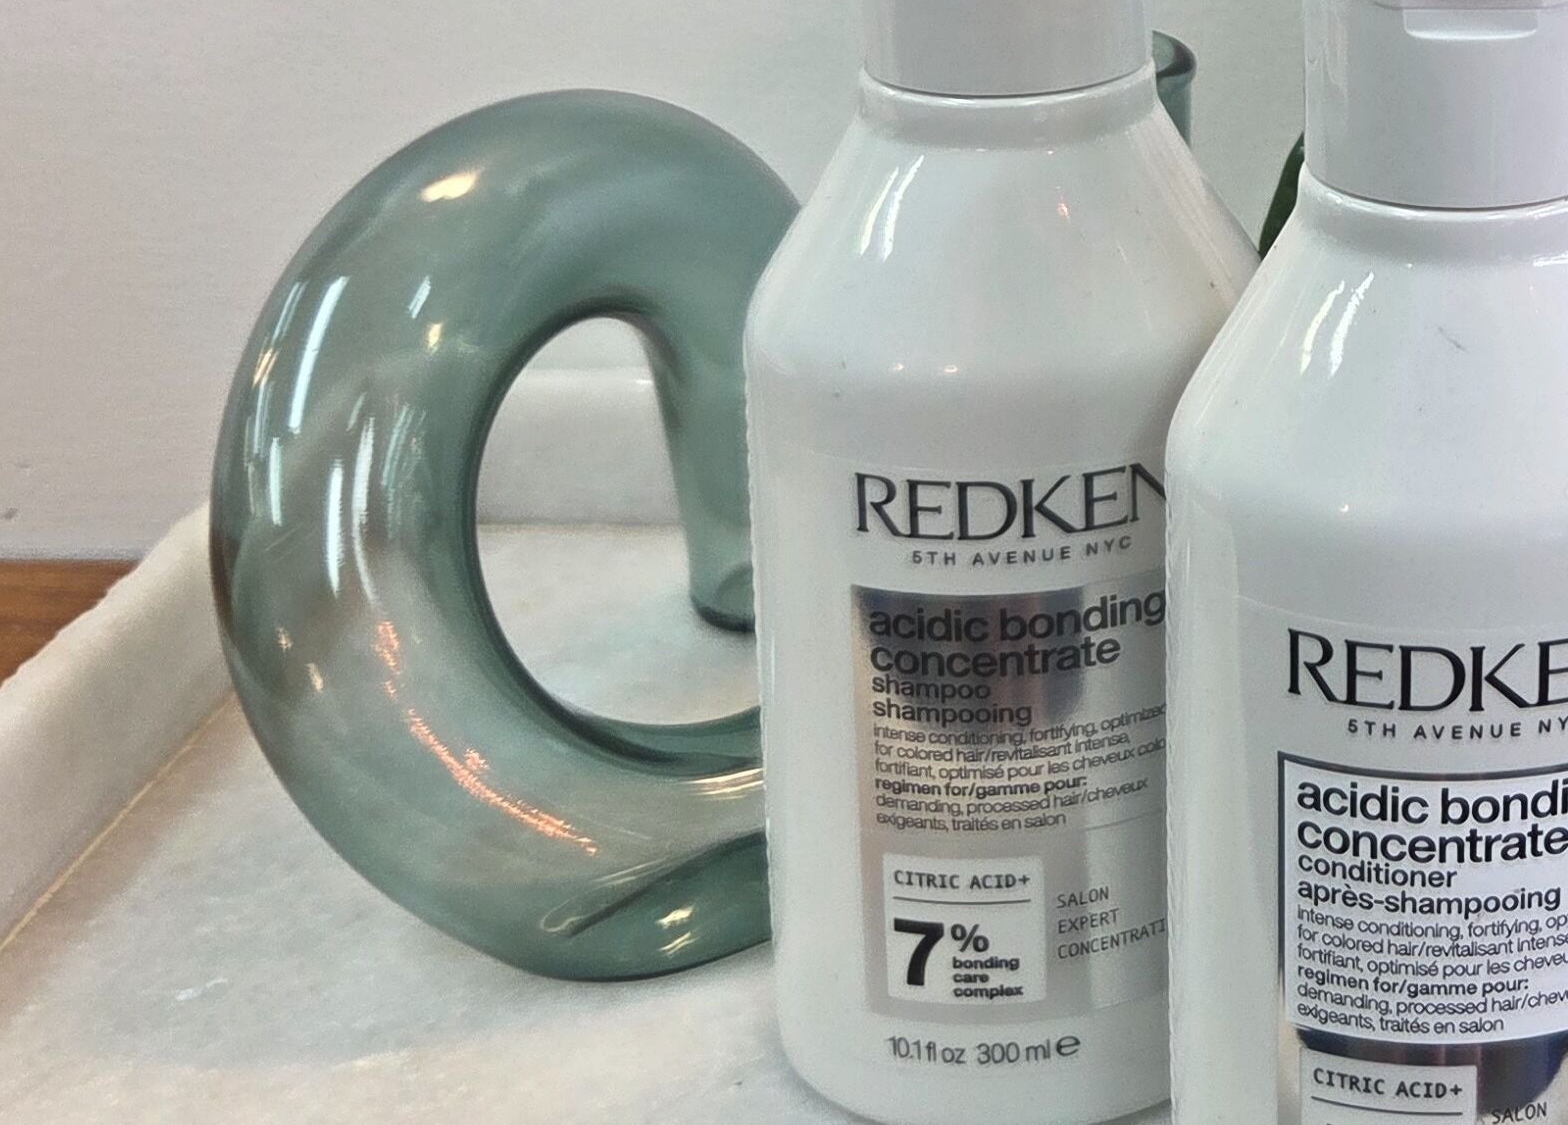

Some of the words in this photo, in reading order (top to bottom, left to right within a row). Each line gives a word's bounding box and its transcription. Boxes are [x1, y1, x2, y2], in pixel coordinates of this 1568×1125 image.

[912, 551, 955, 565] 5TH
[972, 546, 1071, 565] AVENUE
[1085, 536, 1132, 556] NYC
[869, 608, 989, 642] acidic
[1000, 590, 1166, 642] bonding
[870, 637, 1121, 677] concentrate
[872, 673, 991, 703] shampoo
[872, 699, 1032, 726] shampooing
[873, 725, 925, 743] intense
[1348, 719, 1396, 738] 5TH
[1414, 722, 1521, 740] AVENUE
[875, 742, 893, 756] for
[897, 746, 953, 762] colored
[939, 765, 1004, 781] optimisé
[1007, 764, 1044, 780] pour
[1047, 759, 1069, 774] les
[1072, 747, 1135, 772] cheveux
[1137, 738, 1166, 758] colo
[875, 778, 941, 796] regimen
[1044, 776, 1087, 795] pour:
[967, 796, 1050, 817] processed
[1297, 781, 1429, 824] acidic
[952, 815, 998, 832] traités
[1002, 818, 1021, 830] en
[1025, 811, 1066, 828] salon
[893, 870, 959, 889] CITRIC
[970, 874, 1031, 889] ACID+
[1298, 853, 1458, 888] conditioner
[1057, 887, 1109, 908] SALON
[1298, 879, 1561, 920] après-shampooing
[1058, 908, 1120, 933] EXPERT
[1298, 905, 1354, 930] intense
[1058, 918, 1167, 959] CONCENTRATI
[1298, 924, 1318, 943] for
[1321, 932, 1383, 954] colored
[953, 956, 1019, 970] bonding
[1368, 959, 1439, 976] optimisé
[1442, 961, 1483, 979] pour
[1487, 961, 1510, 975] les
[953, 972, 989, 983] care
[1298, 964, 1369, 989] regimen
[1482, 977, 1529, 999] pour:
[954, 984, 1023, 999] complex
[1396, 997, 1488, 1017] processed
[1379, 1016, 1430, 1034] traités
[1434, 1021, 1455, 1034] en
[1459, 1017, 1504, 1034] salon
[942, 1046, 966, 1064] oz
[976, 1042, 1019, 1065] 300
[1025, 1039, 1050, 1061] ml
[1313, 1068, 1384, 1095] CITRIC
[1396, 1082, 1462, 1098] ACID+
[1491, 1101, 1548, 1124] SALON
